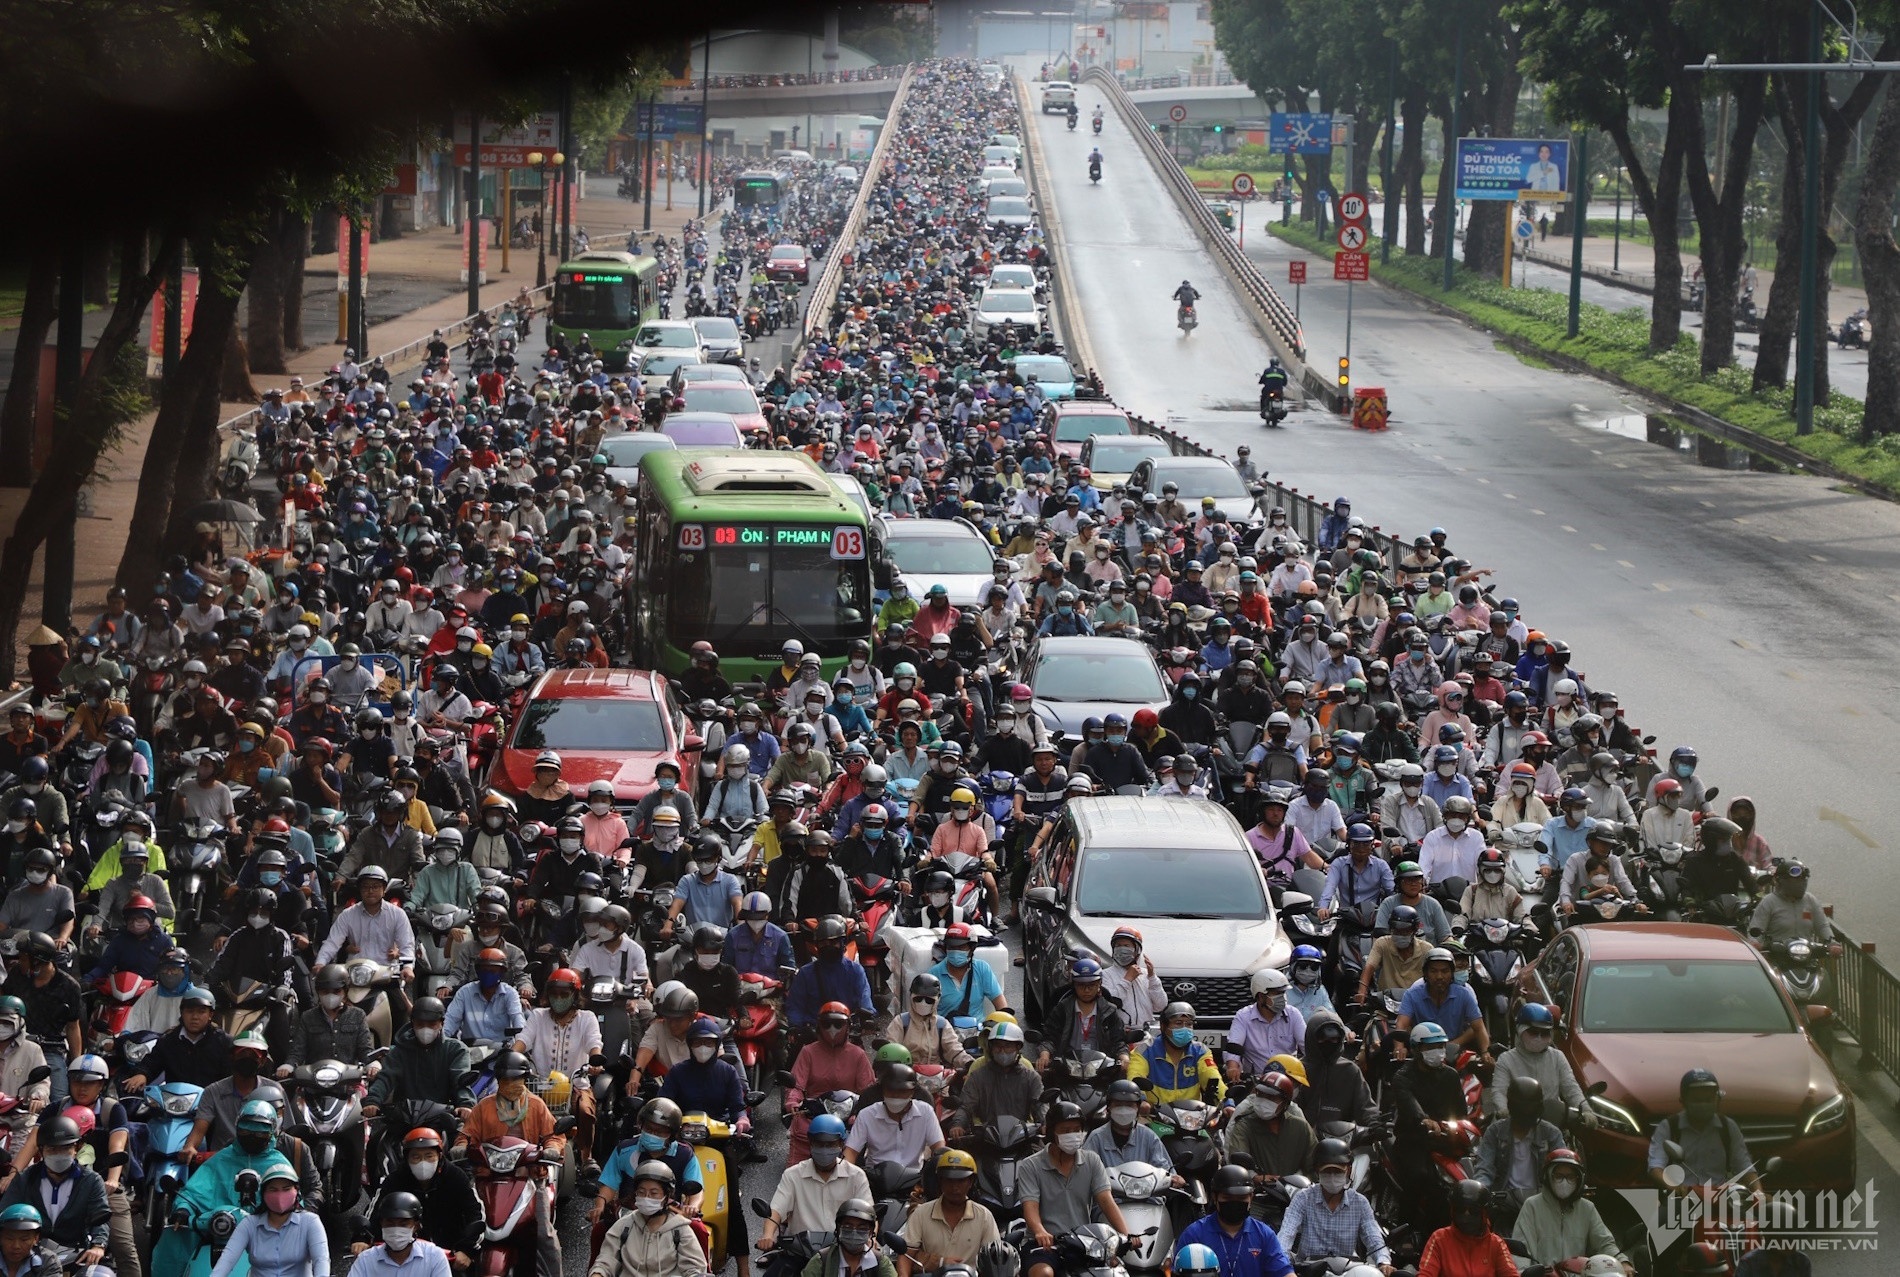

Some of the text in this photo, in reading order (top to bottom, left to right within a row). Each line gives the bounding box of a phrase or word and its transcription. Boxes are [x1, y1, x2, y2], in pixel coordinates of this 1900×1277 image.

[1464, 153, 1521, 164] ĐỦ THUỐC
[1464, 164, 1520, 175] THEO TOA
[1238, 179, 1248, 189] 40
[682, 528, 702, 545] 03
[715, 528, 735, 543] 03
[778, 531, 817, 544] PHẠM
[836, 532, 861, 555] 03
[1183, 1064, 1196, 1078] be
